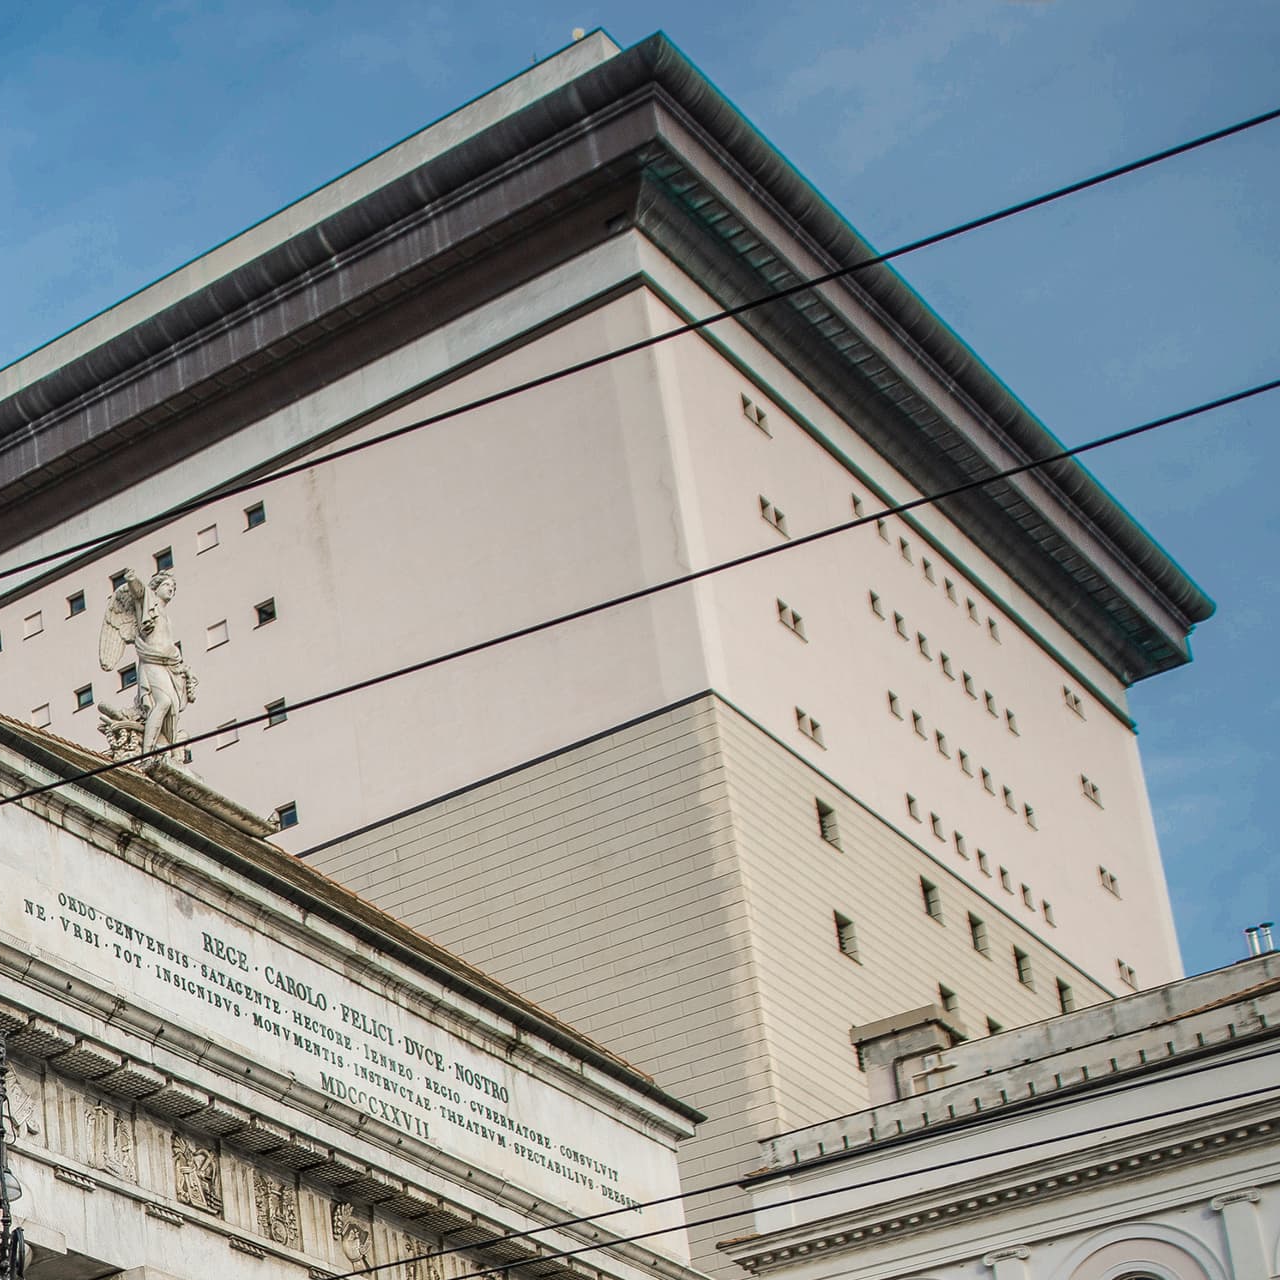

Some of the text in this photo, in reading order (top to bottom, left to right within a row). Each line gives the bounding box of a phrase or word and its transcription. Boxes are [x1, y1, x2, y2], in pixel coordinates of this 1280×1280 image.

[23, 899, 47, 922] NE
[59, 916, 100, 948] VRBI
[113, 943, 142, 969] TOT
[155, 965, 240, 1017] INSIGNIBVS
[252, 1012, 344, 1068] MONVMENTIS
[353, 1063, 431, 1111] INSTRVCTAE
[439, 1105, 506, 1148] THEATRVM
[58, 892, 96, 921] ORDO
[105, 916, 189, 969] GENVENSIS
[201, 964, 281, 1015] SATAGENTE
[292, 1010, 352, 1050] HECTORE
[424, 1076, 460, 1104] REGIO
[559, 1145, 618, 1182] CONSVLVIT
[201, 931, 509, 1104] REGE CAROLO FELICI DVCE NOSTRO
